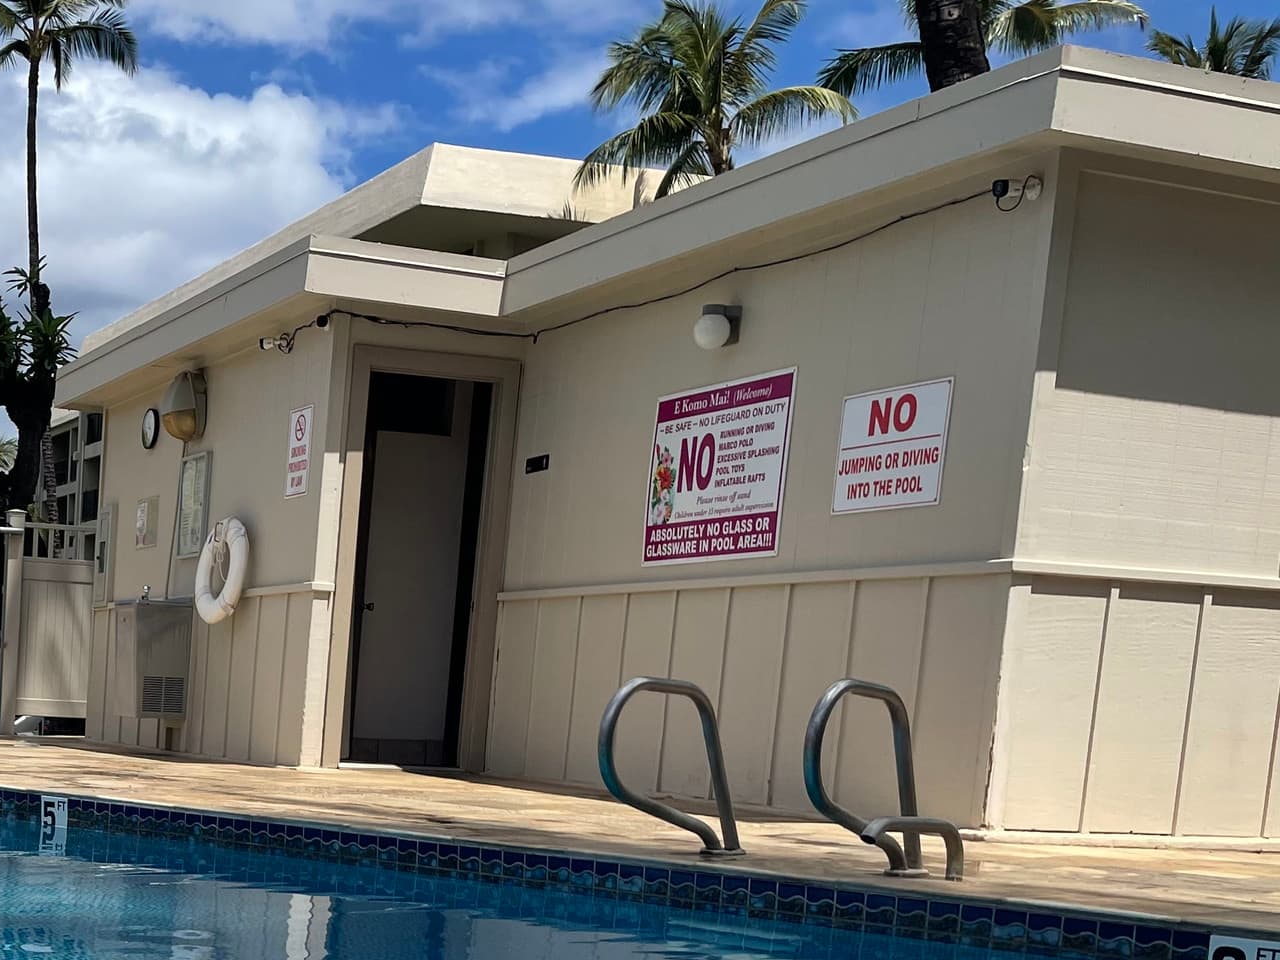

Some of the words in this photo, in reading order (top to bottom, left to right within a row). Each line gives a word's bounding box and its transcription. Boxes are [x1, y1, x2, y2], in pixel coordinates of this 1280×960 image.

[674, 401, 681, 415] E
[682, 397, 708, 413] Komo
[709, 390, 730, 407] Mai!
[733, 383, 773, 405] (Welcome)
[665, 424, 673, 434] BE
[675, 421, 692, 433] SAFE
[699, 417, 710, 427] NO
[710, 409, 751, 426] LIFEGUARD
[752, 407, 764, 417] ON
[765, 402, 786, 415] DUTY
[867, 393, 918, 437] NO
[720, 427, 745, 439] RUNNING
[746, 425, 754, 435] OR
[755, 421, 775, 433] DIVING
[717, 450, 747, 463] EXCESSIVE
[747, 445, 780, 459] SPLASHING
[718, 440, 738, 451] MARCO
[739, 437, 754, 448] POLO
[677, 432, 716, 494] NO
[715, 466, 730, 476] POOL
[731, 463, 745, 473] TOYS
[838, 454, 882, 476] JUMPING
[885, 452, 899, 470] OR
[901, 446, 940, 468] DIVING
[714, 475, 747, 488] INFLATABLE
[747, 472, 766, 483] RAFTS
[847, 482, 870, 501] INTO
[873, 479, 892, 497] THE
[894, 475, 923, 495] POOL
[650, 524, 705, 542] ABSOLUTELY
[706, 522, 721, 537] NO
[722, 519, 753, 535] GLASS
[755, 517, 769, 531] OR
[646, 540, 697, 557] GLASSWARE
[699, 540, 709, 553] IN
[710, 536, 735, 552] POOL
[737, 532, 773, 549] AREA!!!
[43, 800, 56, 826] 5
[57, 800, 66, 812] FT
